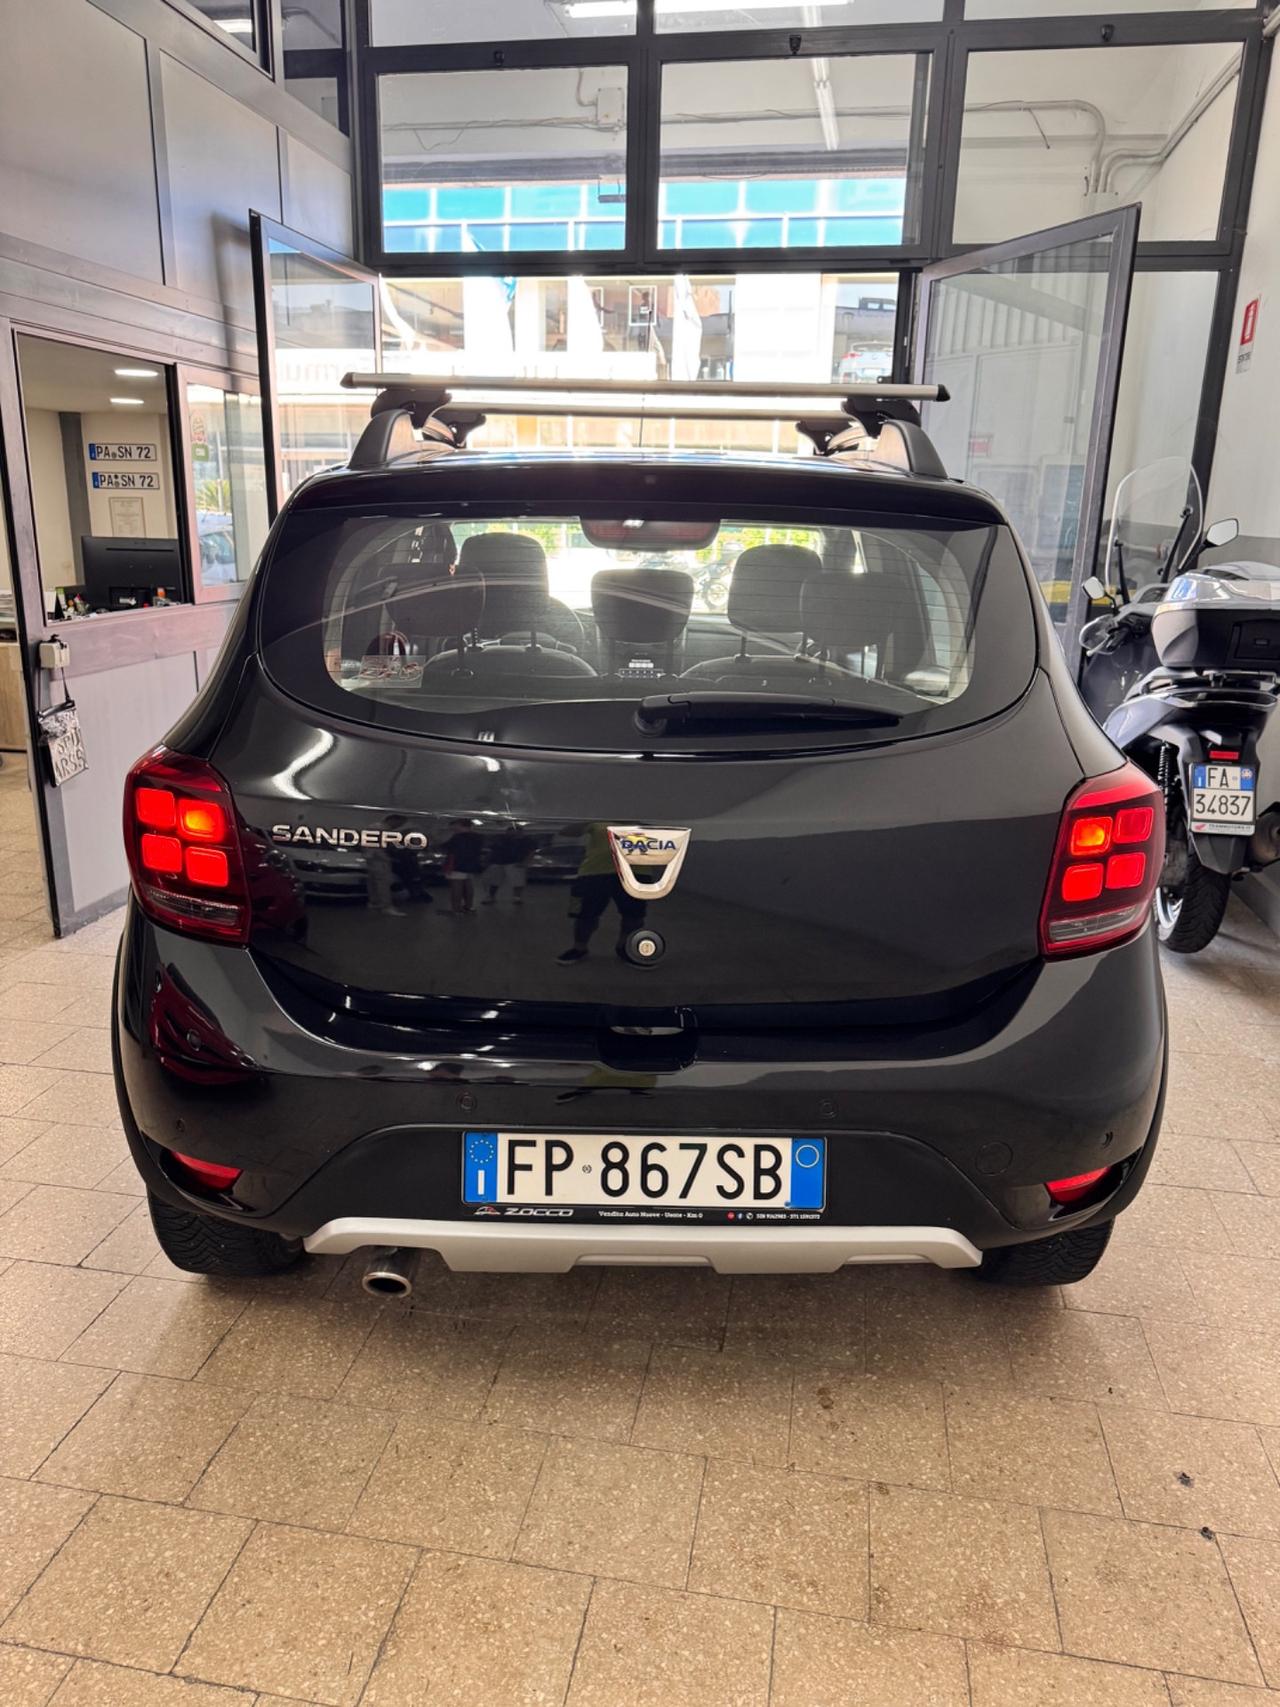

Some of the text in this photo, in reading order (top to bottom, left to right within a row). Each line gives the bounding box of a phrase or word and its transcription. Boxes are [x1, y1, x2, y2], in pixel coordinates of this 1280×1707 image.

[96, 445, 151, 459] PA SN 72
[99, 474, 154, 488] PA SN 72
[1207, 767, 1229, 788] FA
[1195, 793, 1251, 816] 34837
[272, 824, 428, 850] SANDERO
[621, 840, 677, 851] DACIA
[507, 1139, 574, 1196] FP
[600, 1141, 783, 1200] 867SB
[504, 1208, 574, 1217] ZOCCO
